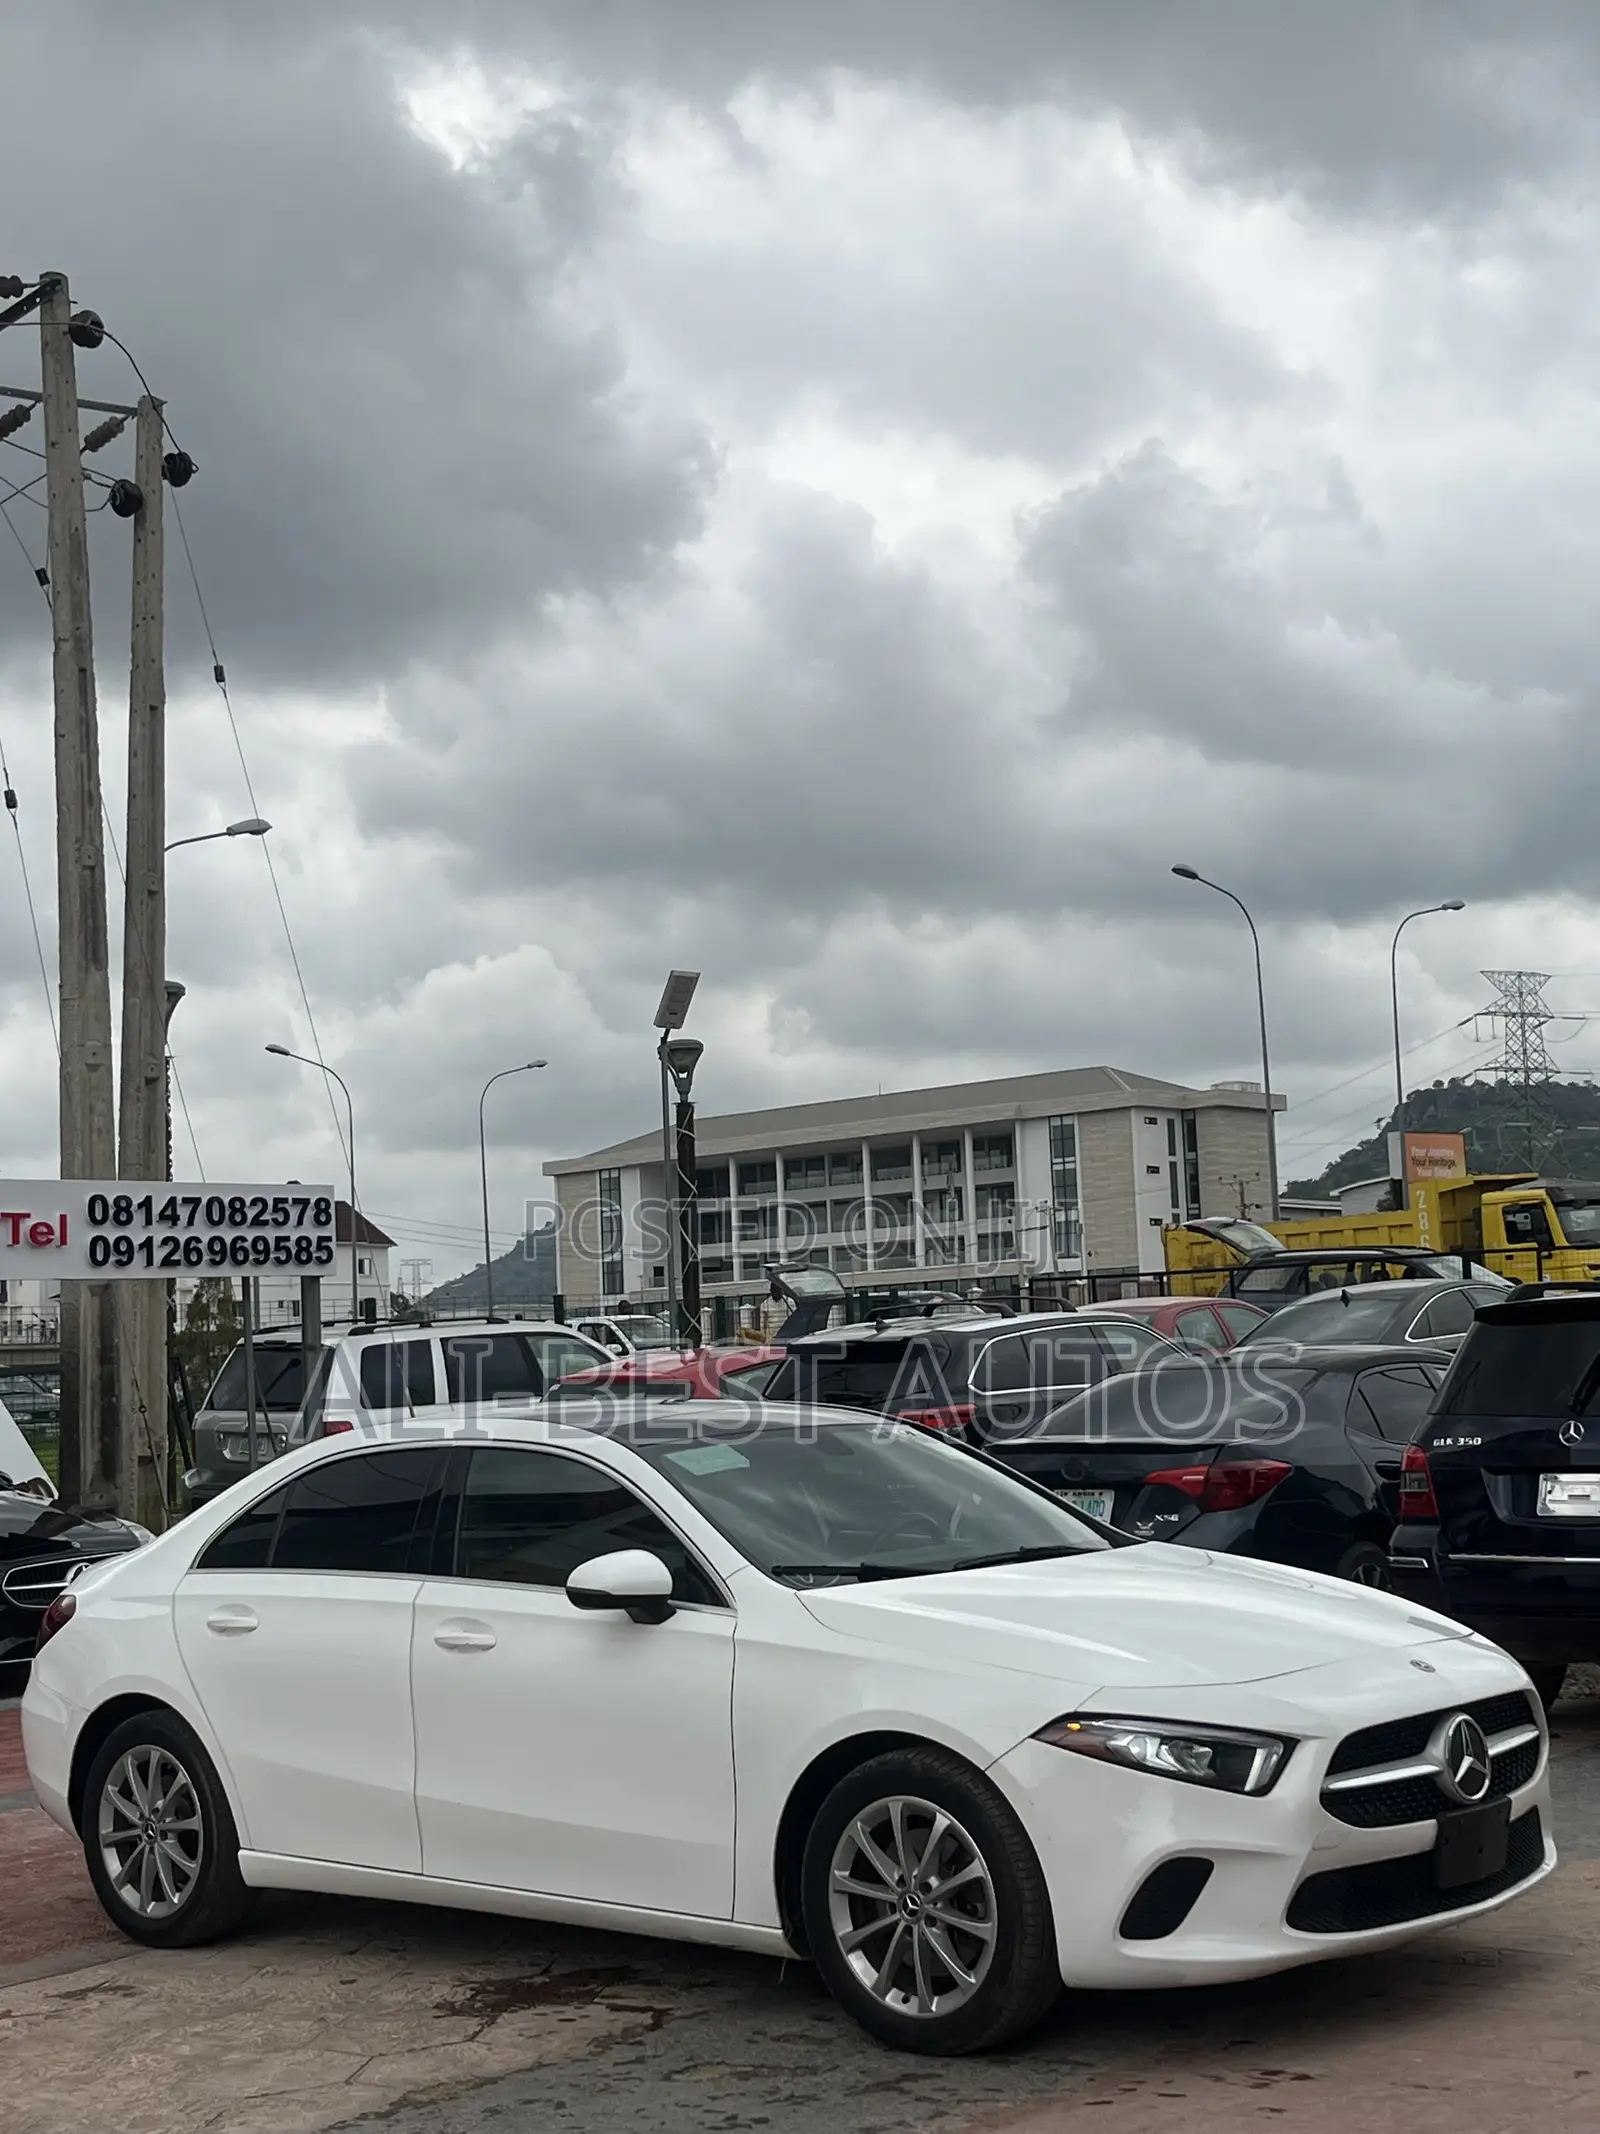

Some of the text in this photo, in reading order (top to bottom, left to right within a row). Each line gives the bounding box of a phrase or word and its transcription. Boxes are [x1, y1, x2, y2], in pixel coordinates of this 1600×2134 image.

[87, 1194, 332, 1227] 08147082578
[1, 1212, 69, 1247] Tel
[88, 1235, 333, 1268] 09126969585
[1433, 1437, 1482, 1447] GLK 350
